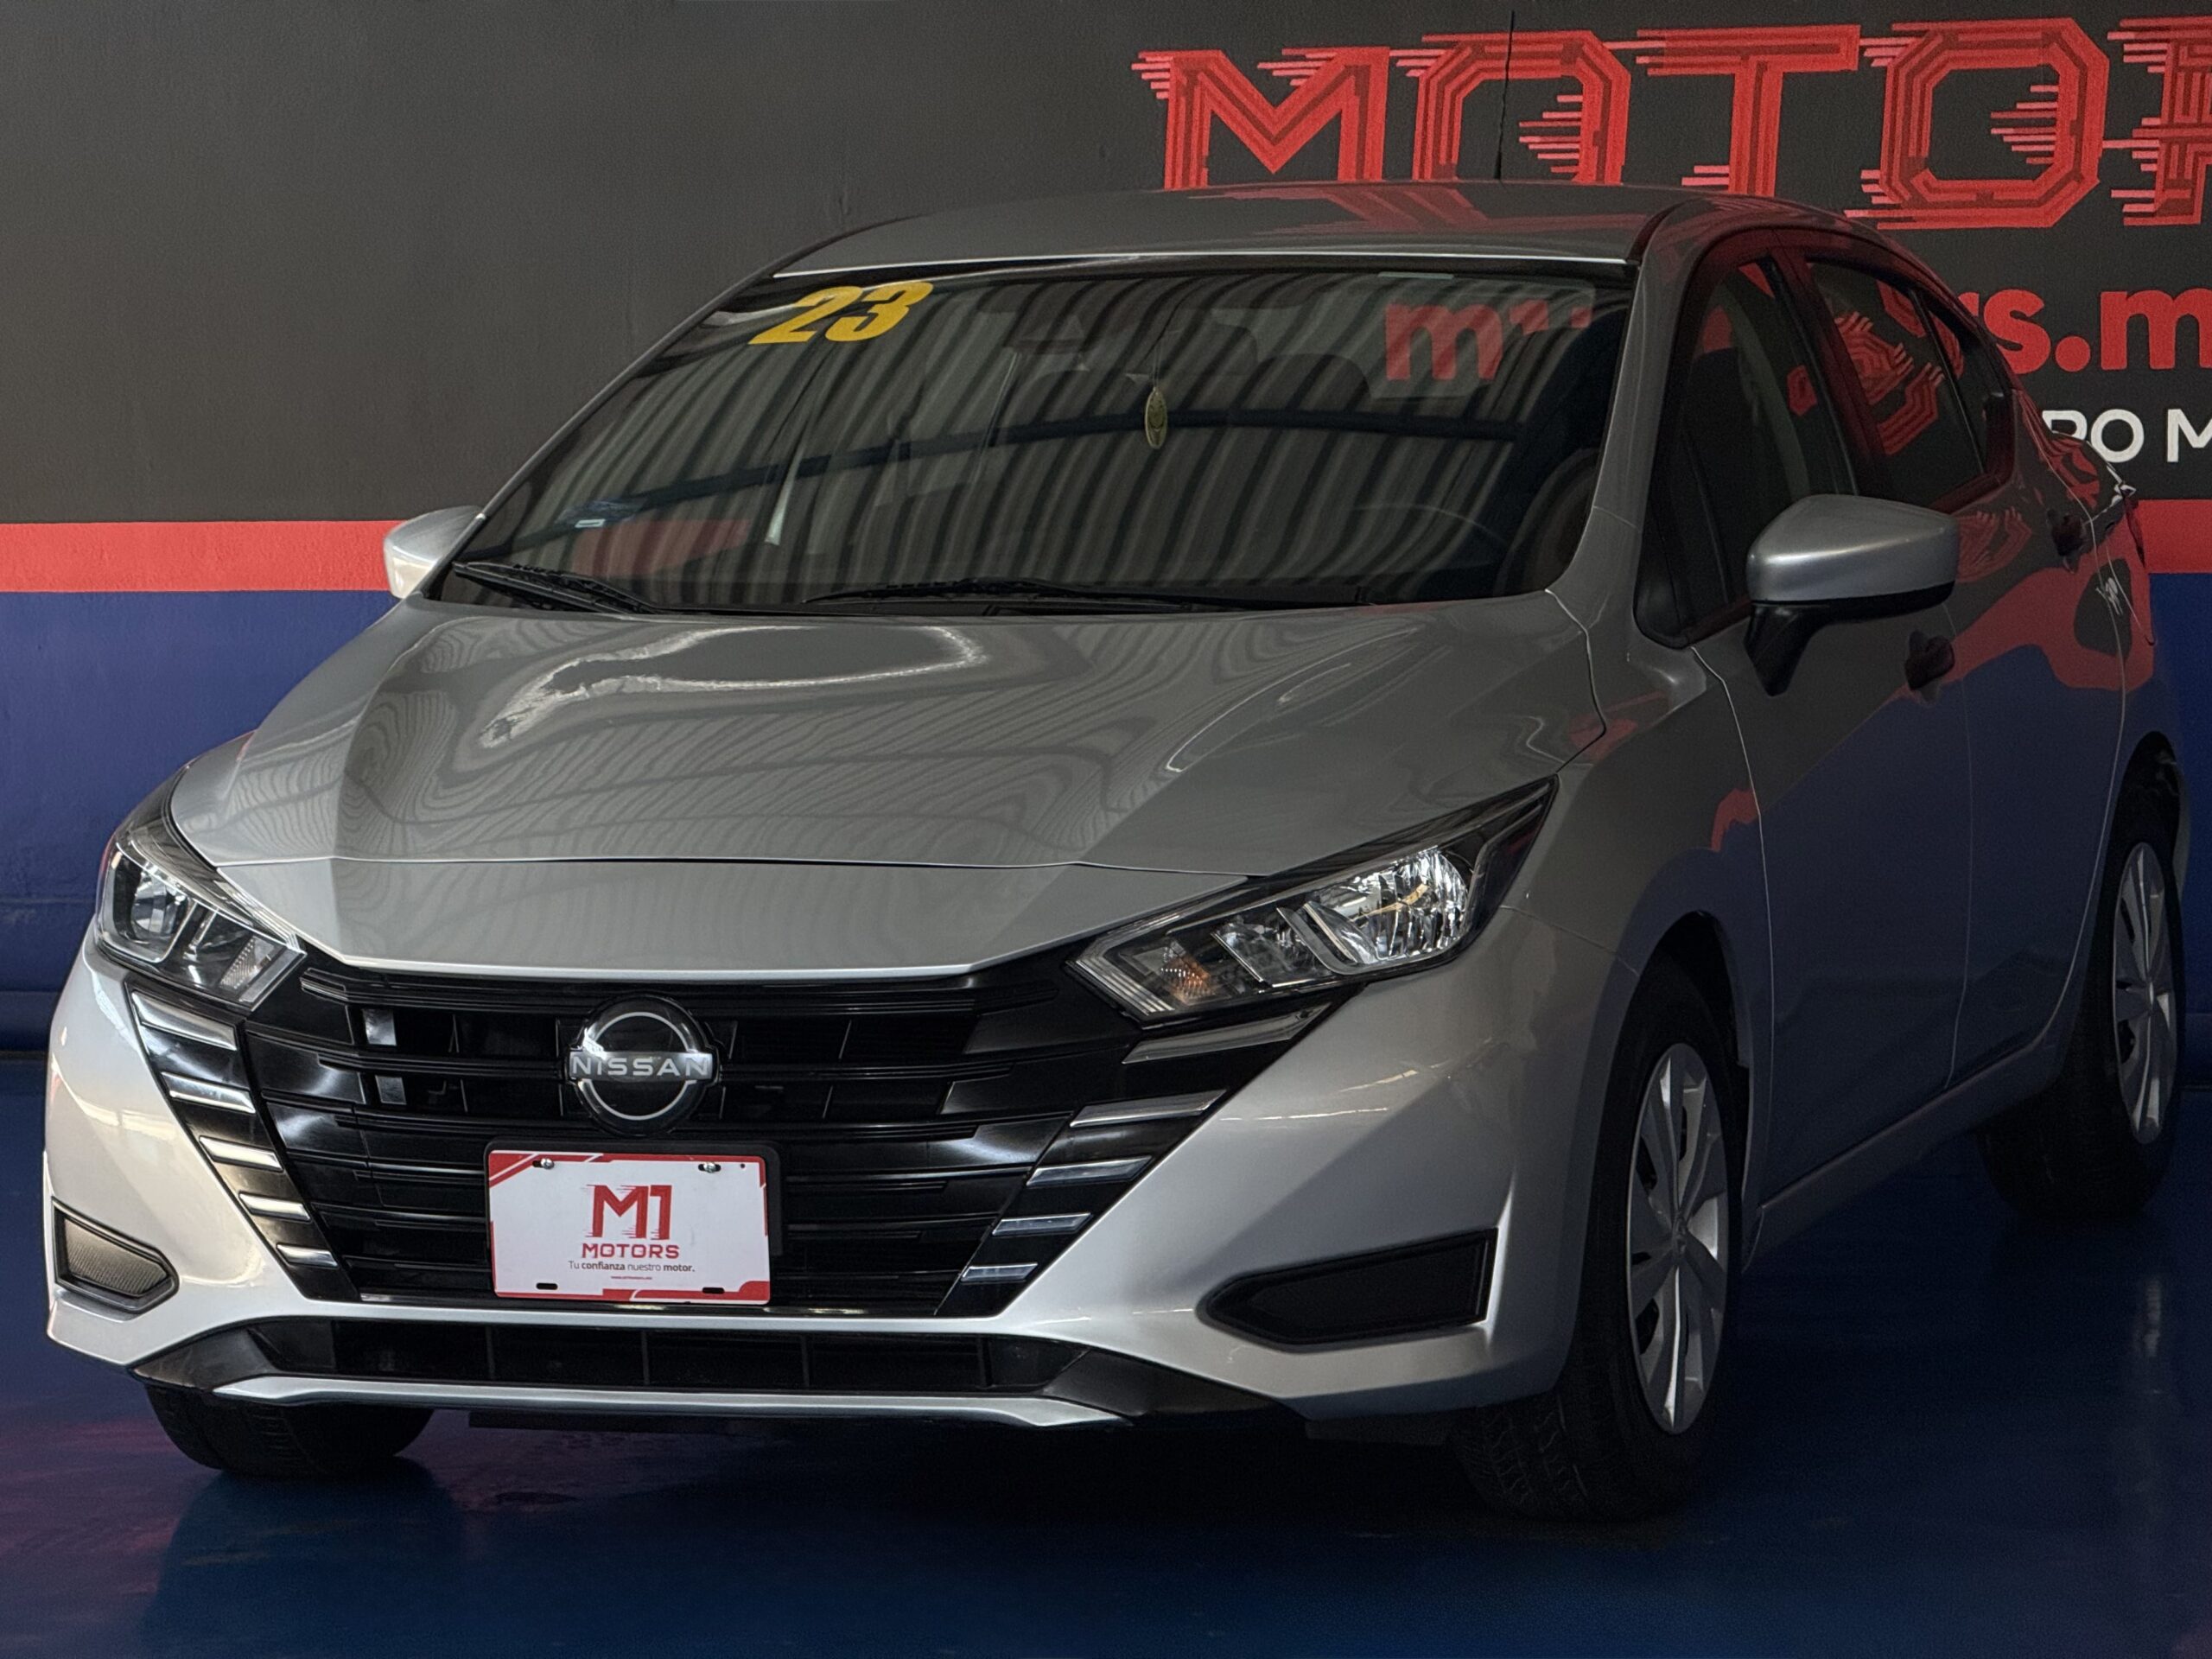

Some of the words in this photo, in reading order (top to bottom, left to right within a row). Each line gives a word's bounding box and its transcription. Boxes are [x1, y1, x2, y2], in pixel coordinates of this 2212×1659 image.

[747, 281, 934, 345] 23
[572, 1056, 709, 1077] NISSAN
[581, 1184, 672, 1240] M1
[582, 1243, 680, 1259] MOTORS
[568, 1260, 580, 1269] Tu
[581, 1261, 626, 1271] confianza
[627, 1263, 662, 1272] nuestro
[663, 1264, 696, 1273] motor.
